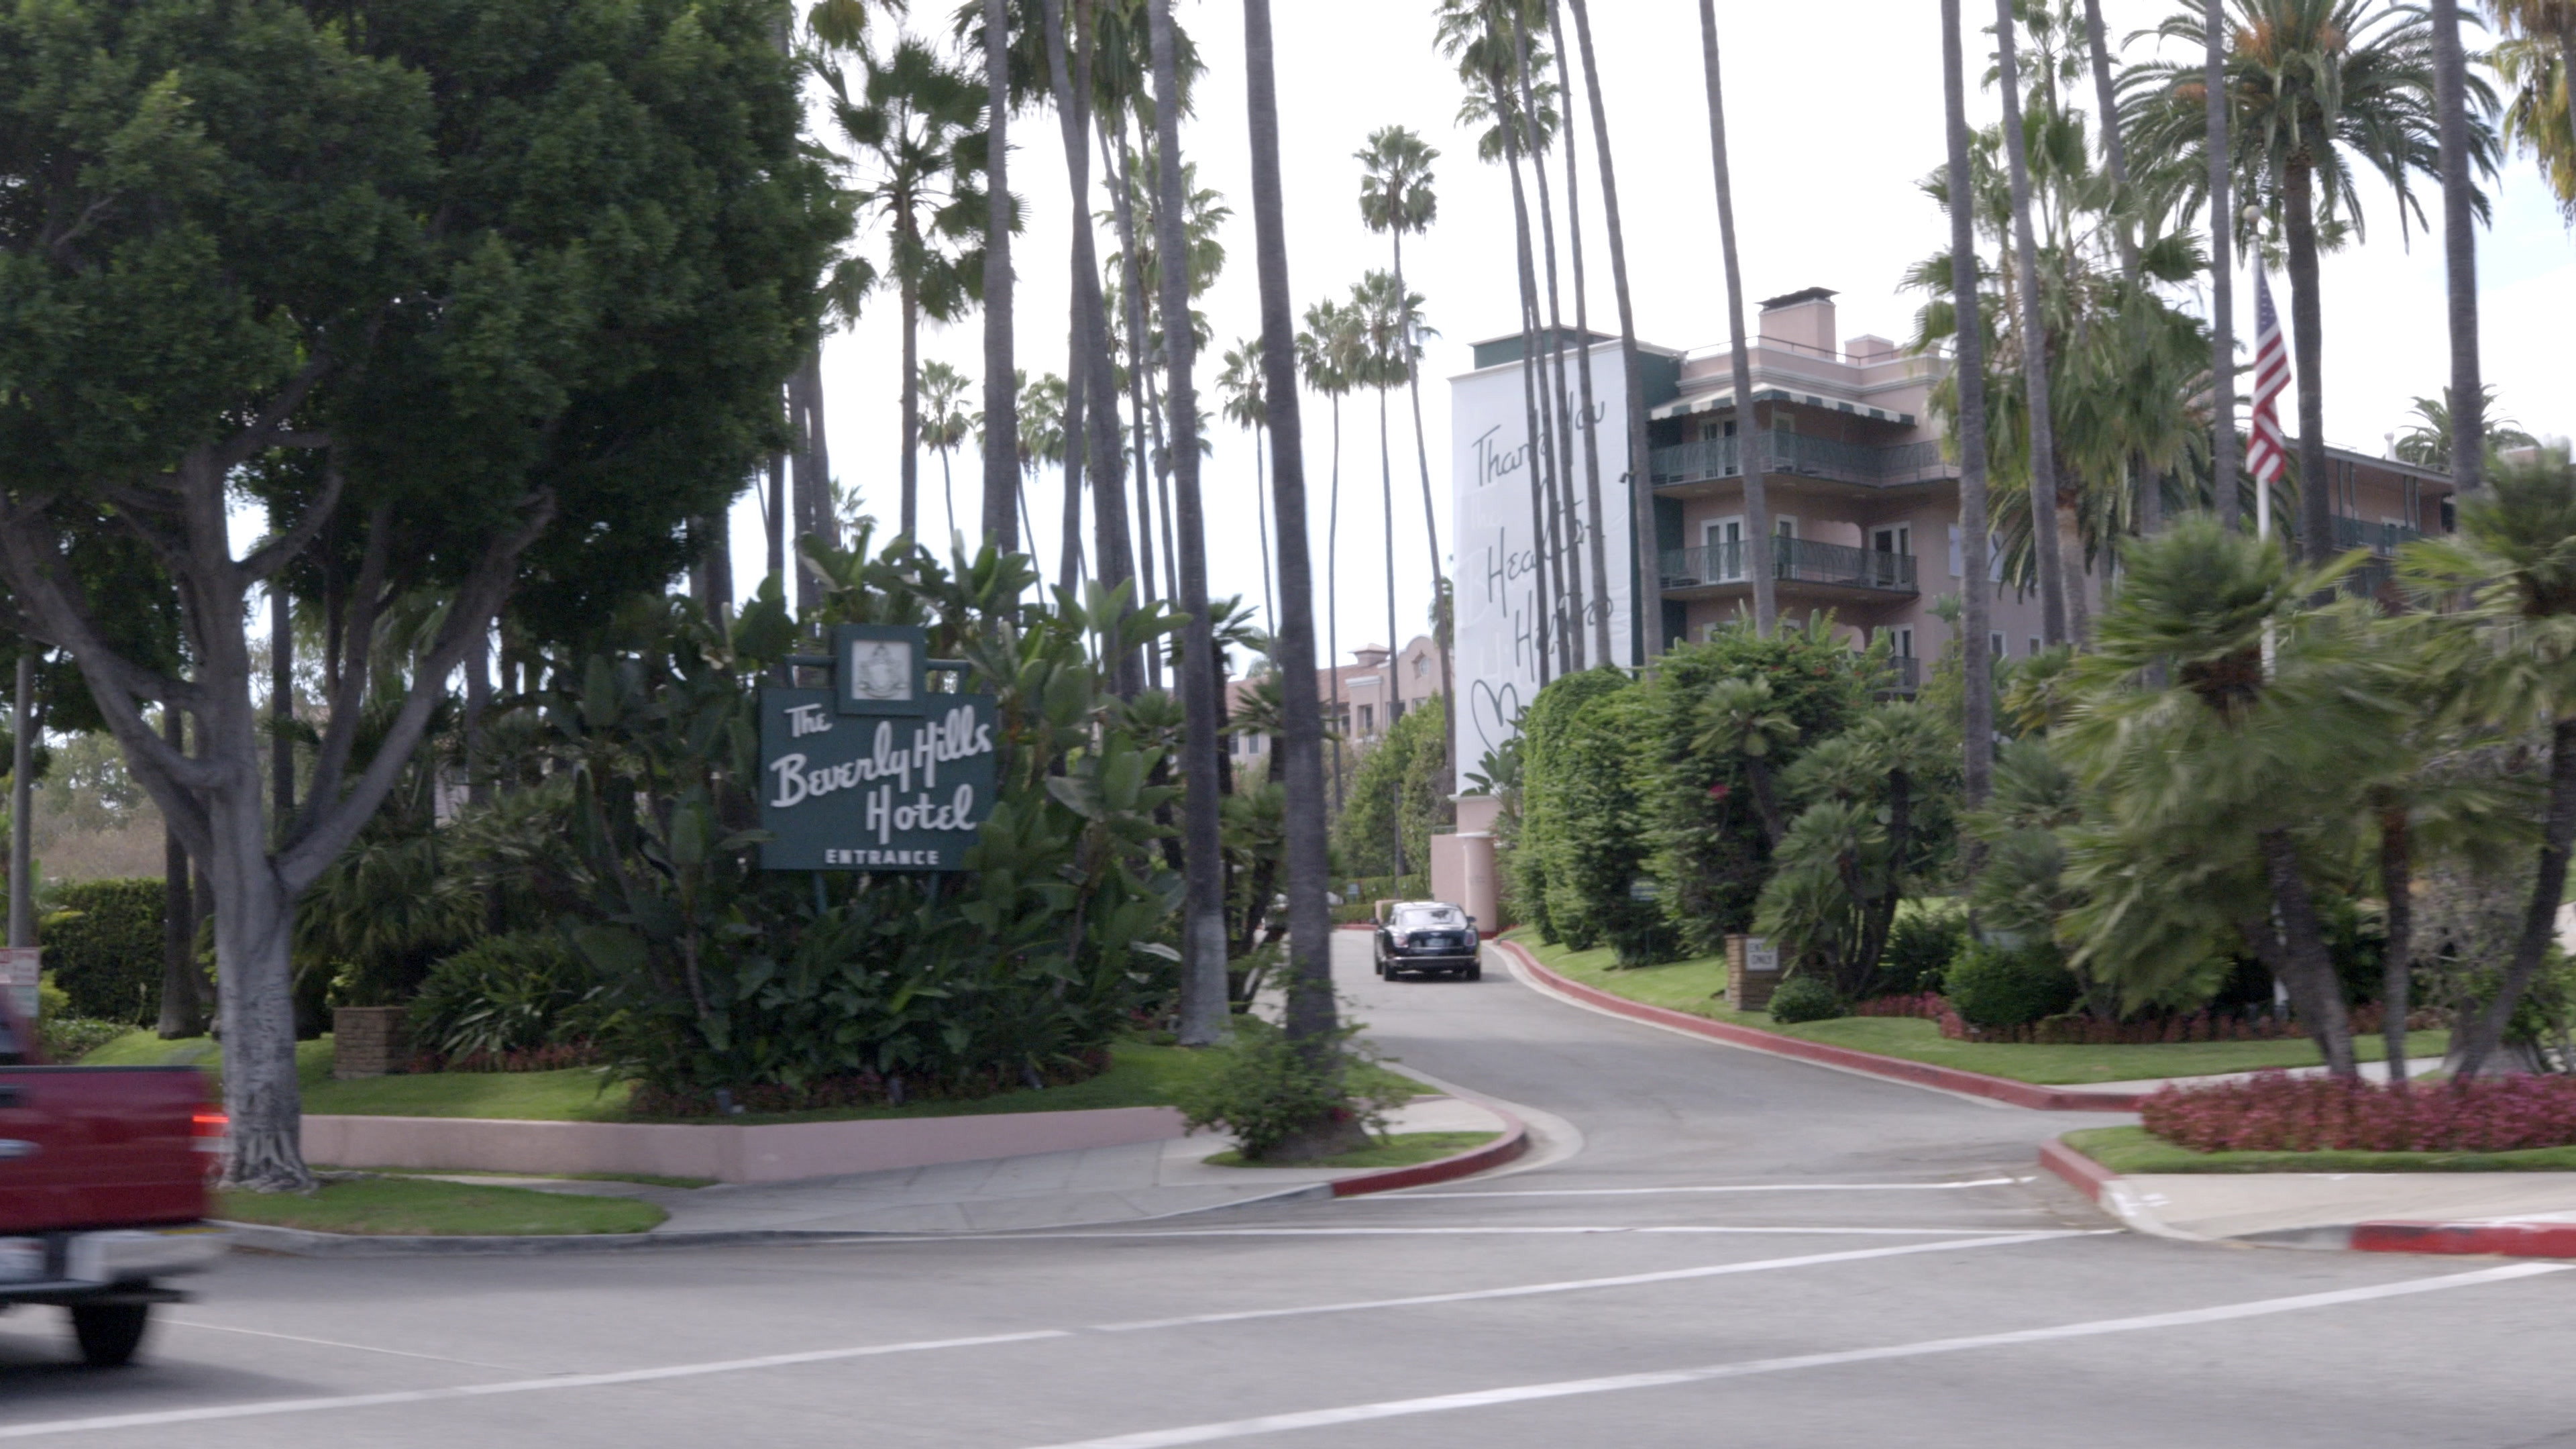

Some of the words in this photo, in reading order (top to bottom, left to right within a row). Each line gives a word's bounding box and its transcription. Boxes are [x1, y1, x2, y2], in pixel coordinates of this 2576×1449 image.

[784, 703, 833, 737] The
[769, 720, 910, 807] Beverly
[913, 704, 993, 788] Hills
[866, 784, 977, 845] Hotel
[824, 848, 939, 865] ENTRANCE
